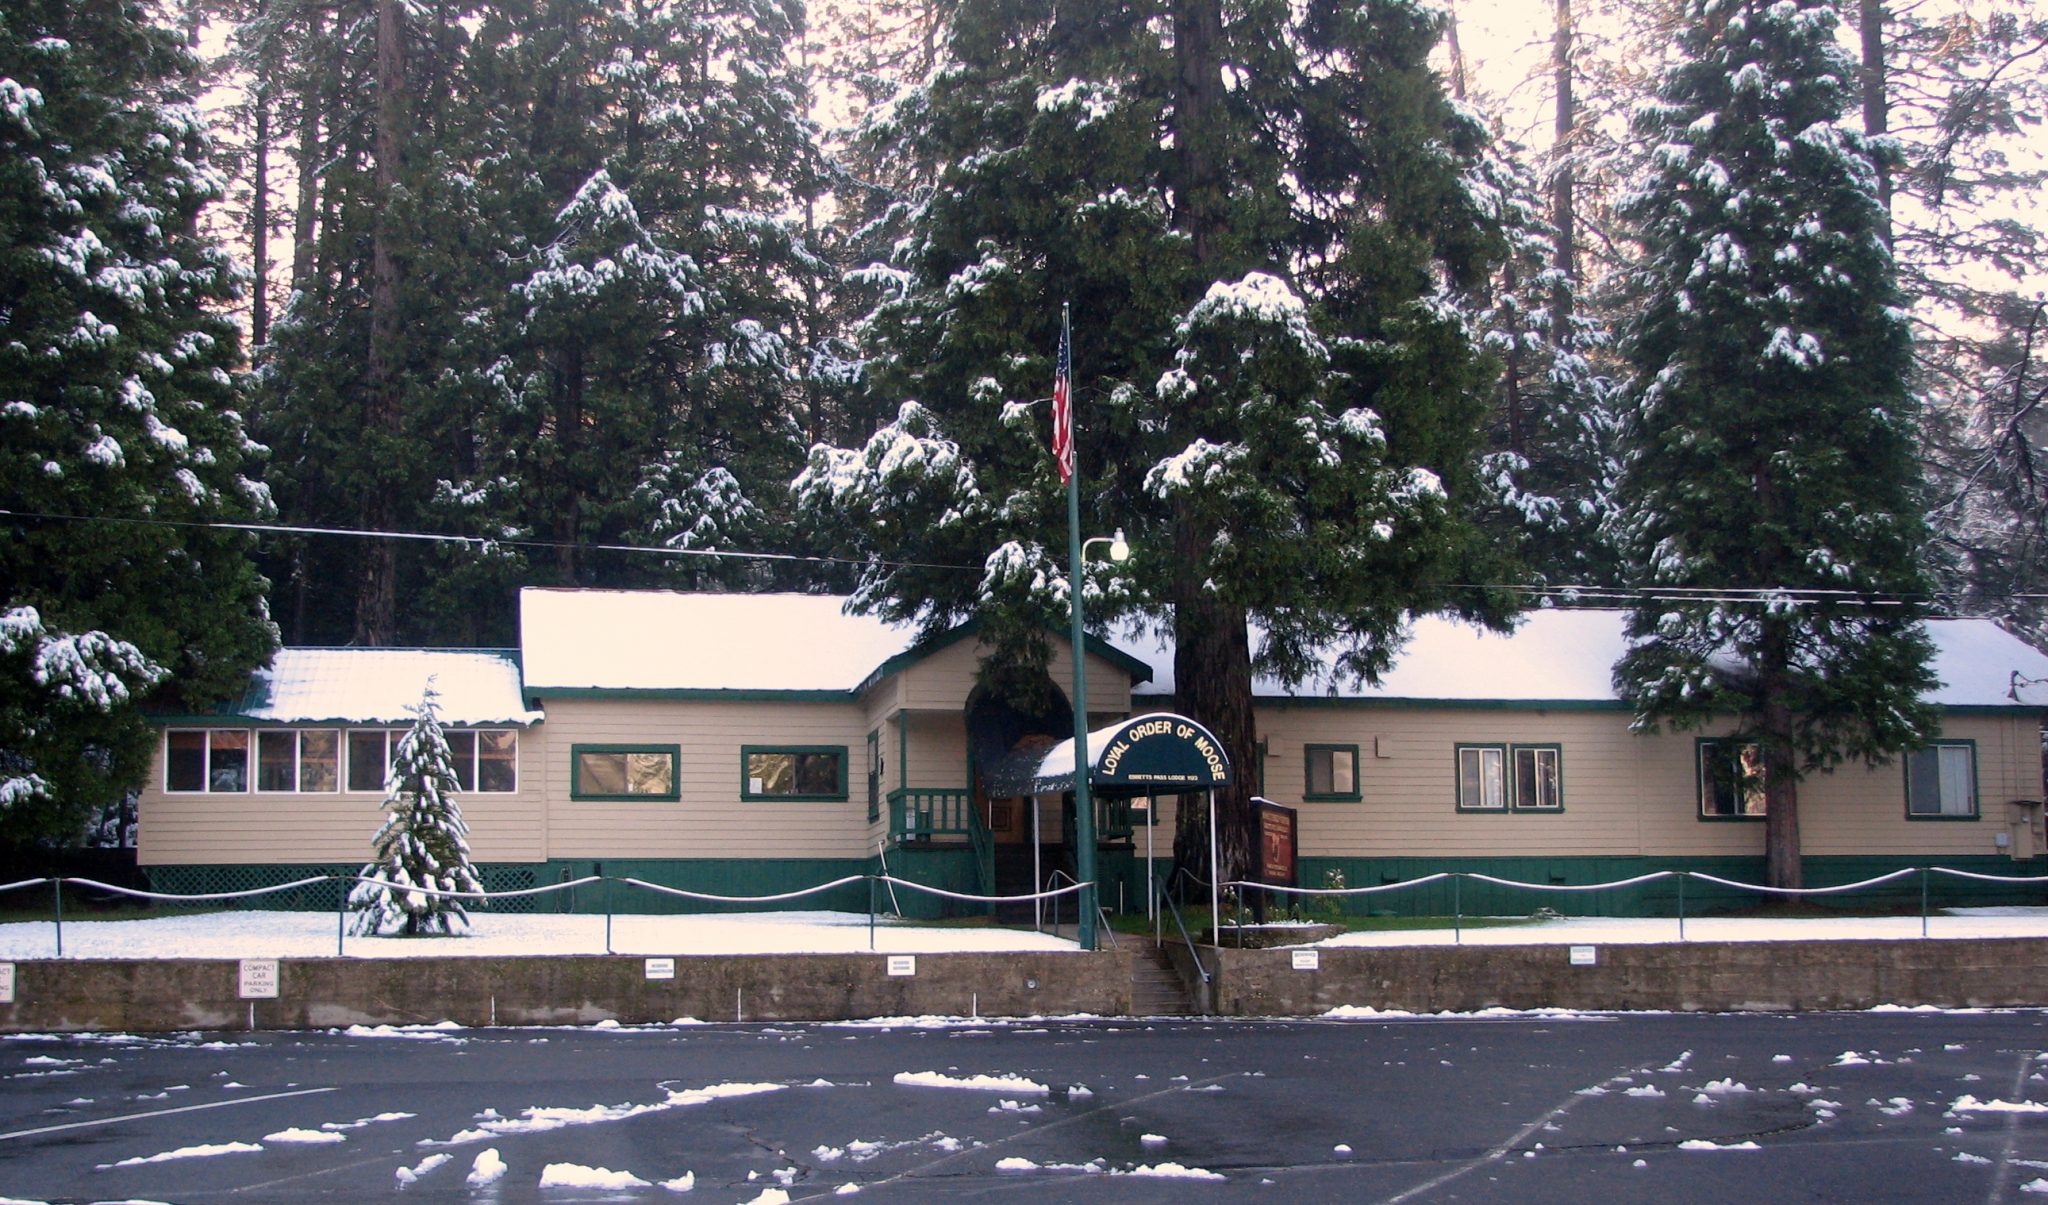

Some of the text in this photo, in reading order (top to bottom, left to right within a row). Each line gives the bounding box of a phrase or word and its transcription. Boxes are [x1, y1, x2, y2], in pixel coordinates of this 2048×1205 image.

[1102, 721, 1226, 781] LOYAL ORDER OF MOOSE
